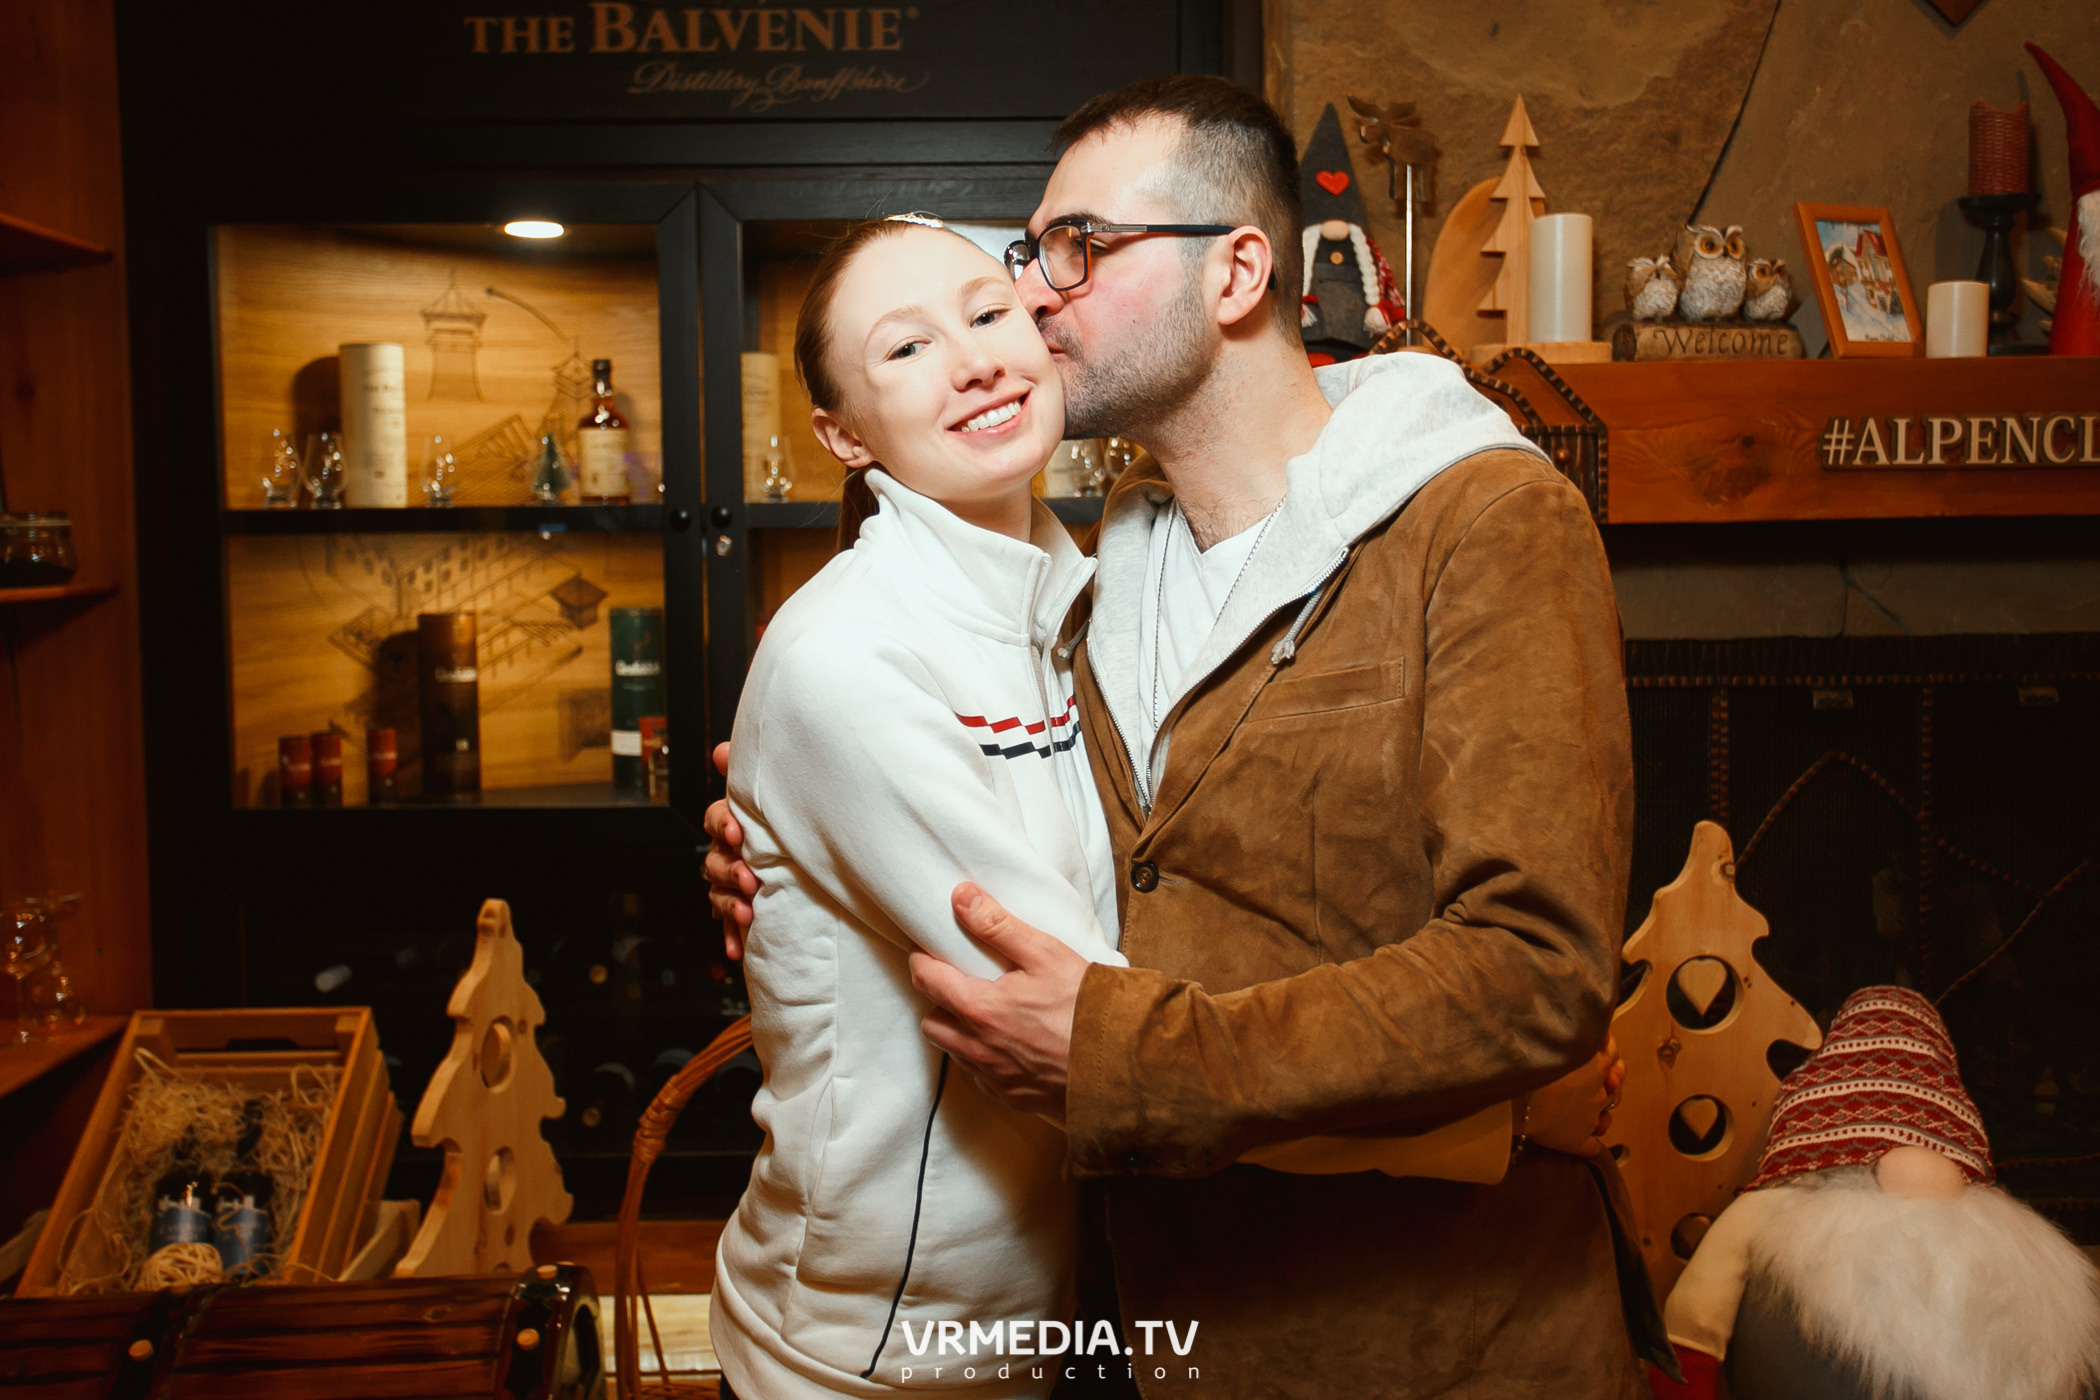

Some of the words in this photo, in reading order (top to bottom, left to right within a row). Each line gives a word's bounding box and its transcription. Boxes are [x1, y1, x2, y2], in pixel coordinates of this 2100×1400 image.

[463, 16, 575, 53] THE
[587, 2, 904, 53] BALVENIE
[626, 60, 774, 113] Distillery
[1654, 330, 1789, 356] Welcome
